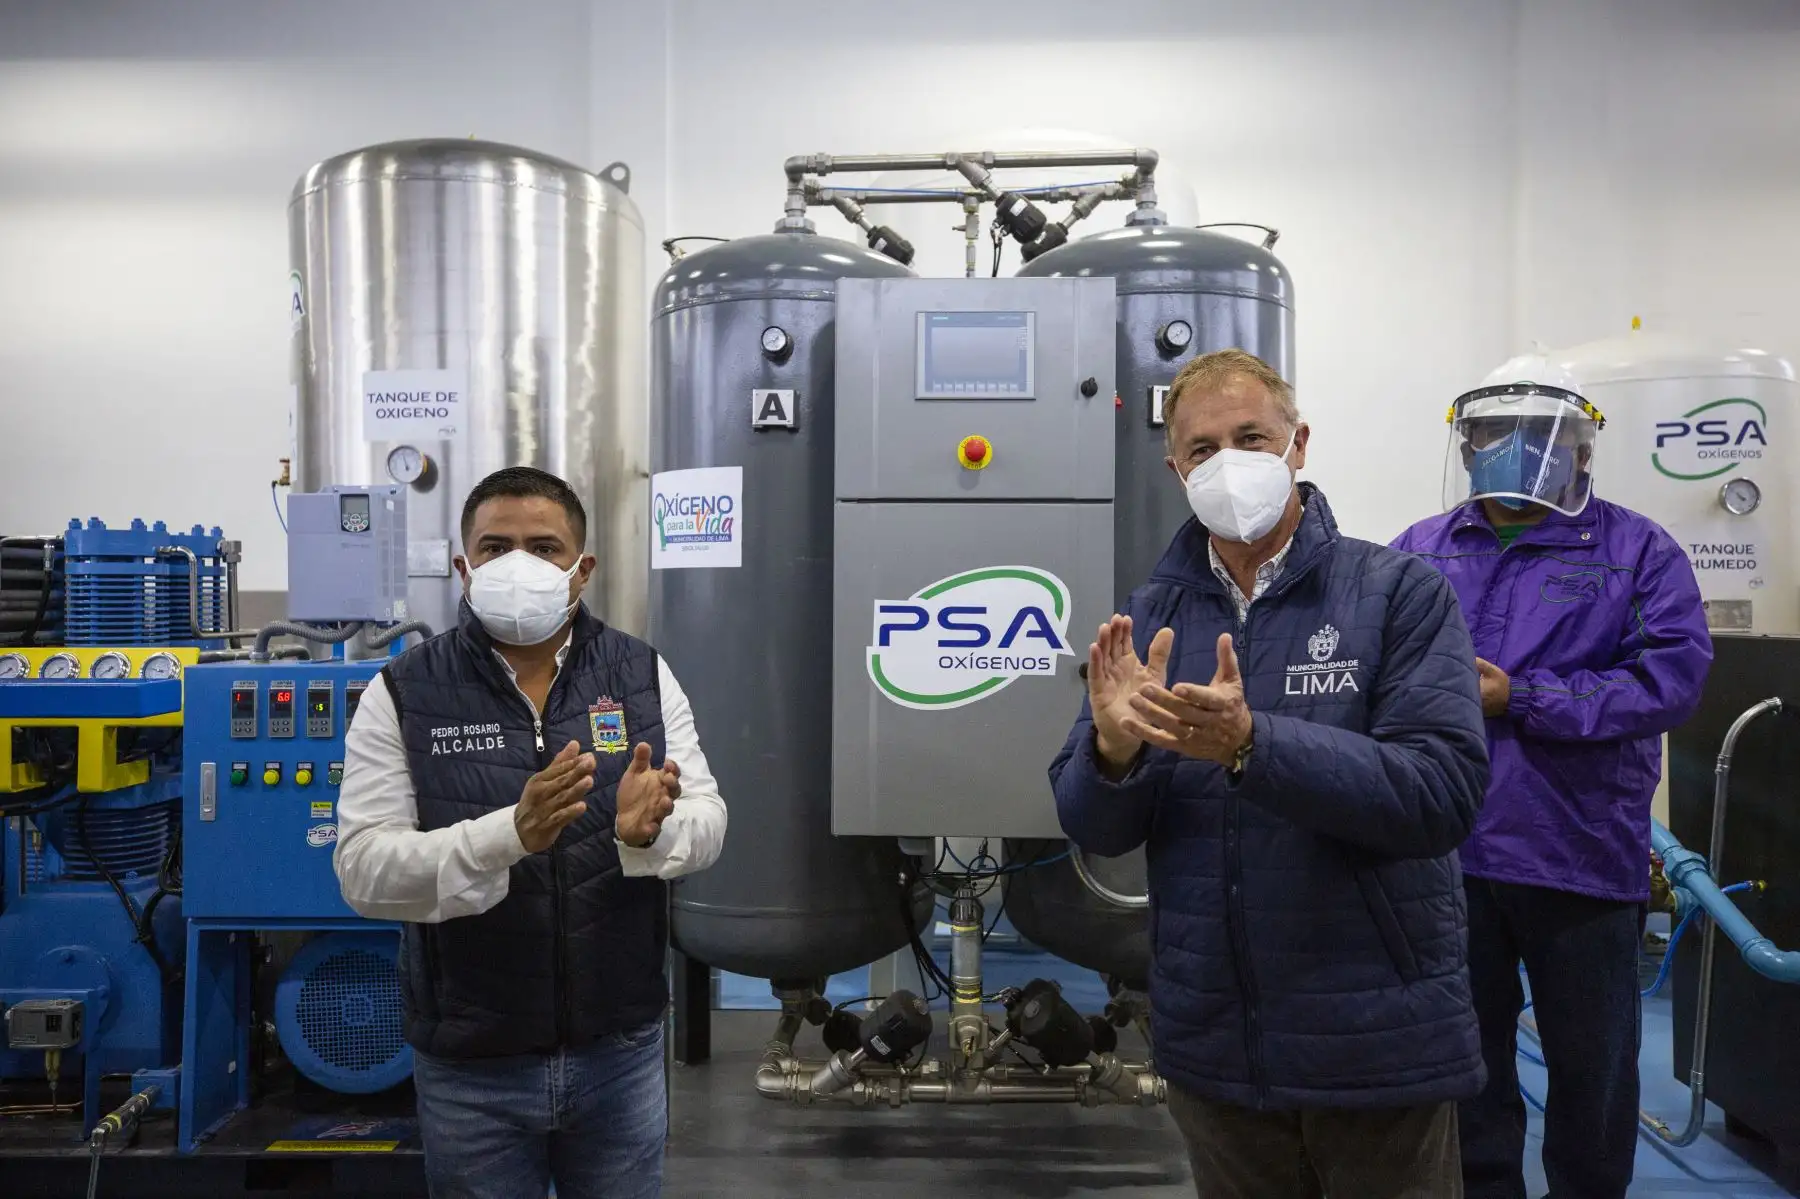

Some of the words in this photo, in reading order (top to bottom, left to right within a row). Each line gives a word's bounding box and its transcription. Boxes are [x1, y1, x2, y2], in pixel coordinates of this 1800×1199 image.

[367, 392, 431, 404] TANQUE
[435, 392, 459, 403] DE
[758, 393, 787, 420] A
[375, 407, 449, 419] OXIGENO
[1656, 420, 1767, 448] PSA
[1697, 448, 1762, 460] OXÍGENOS
[667, 520, 684, 533] para
[685, 519, 694, 530] la
[695, 508, 734, 536] Vida
[1689, 544, 1755, 555] TANQUE
[879, 605, 1064, 649] PSA
[938, 652, 1050, 670] OXÍGENOS
[1287, 661, 1347, 672] MUNICIPALIDAD
[1348, 659, 1359, 667] DE
[1285, 671, 1359, 695] LIMA
[431, 727, 460, 738] PEDRO
[463, 723, 500, 735] ROSARIO
[431, 736, 506, 756] ALCALDE
